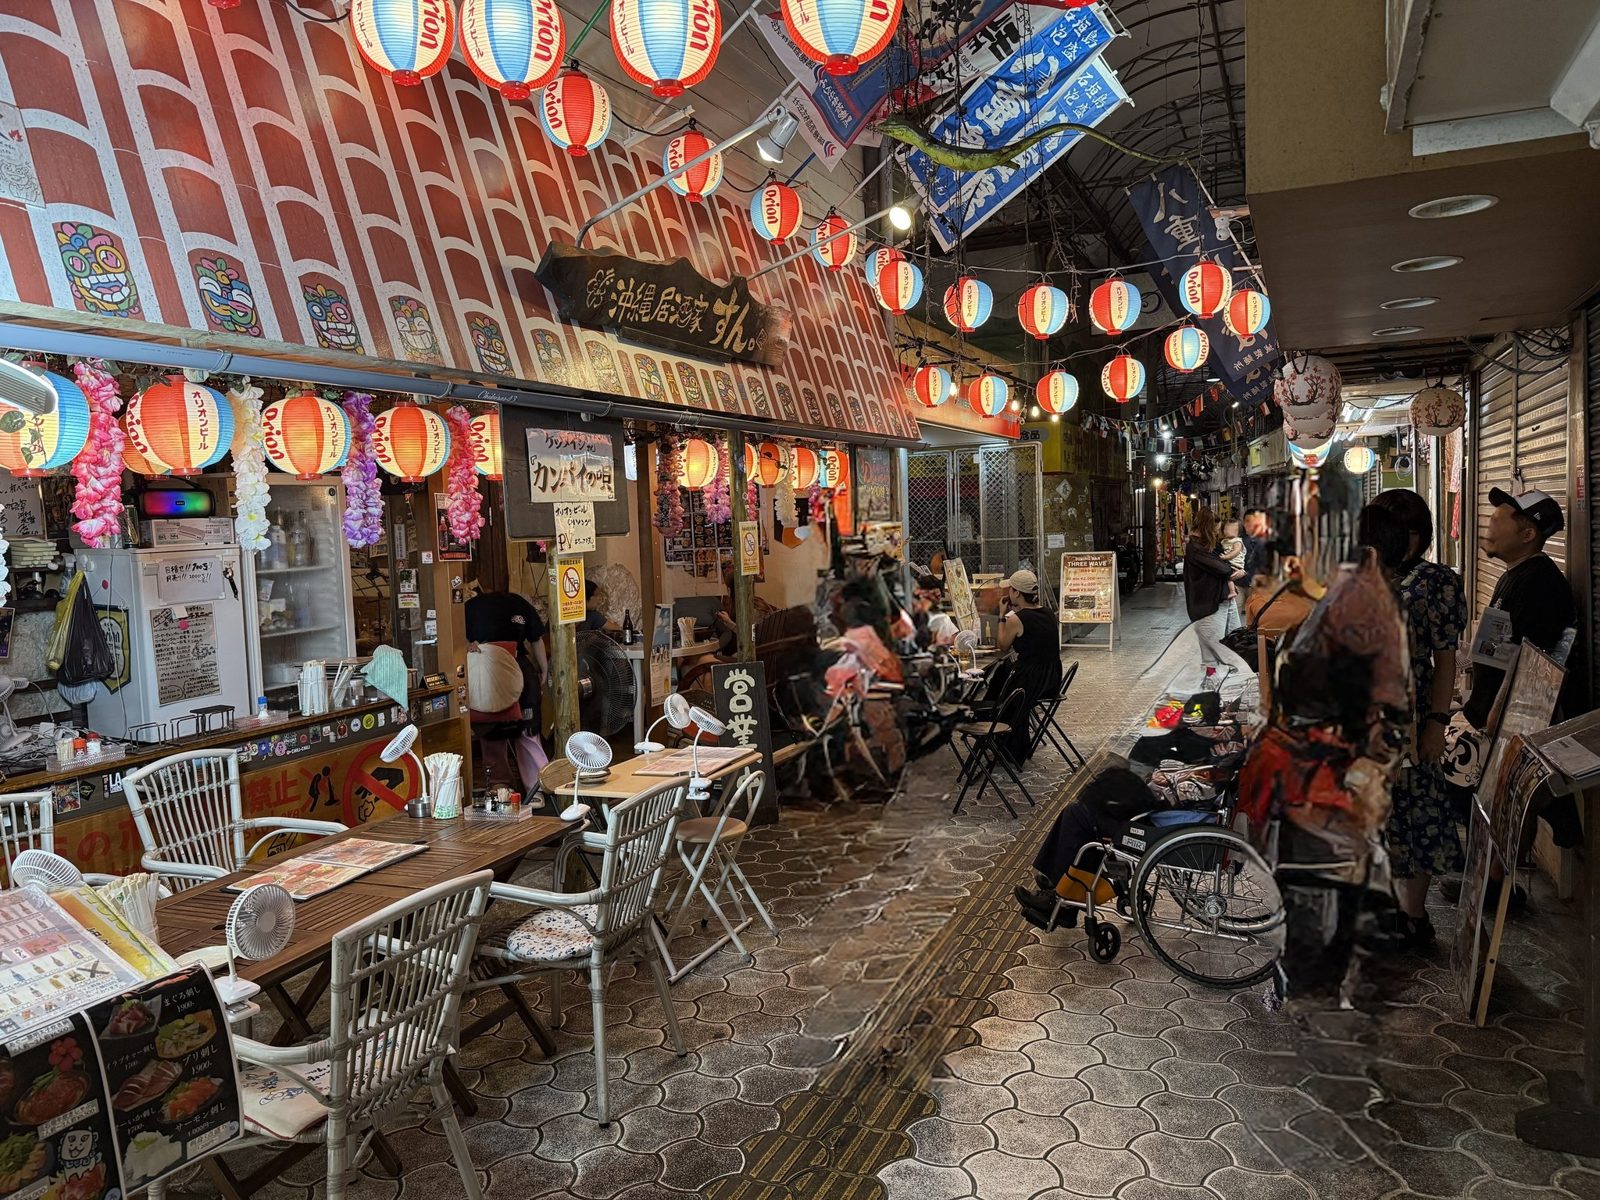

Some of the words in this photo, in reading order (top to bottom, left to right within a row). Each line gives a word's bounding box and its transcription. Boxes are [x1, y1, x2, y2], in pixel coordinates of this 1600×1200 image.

[419, 0, 445, 50] rion
[1050, 26, 1077, 61] 泡盛
[1063, 7, 1099, 48] 石垣島
[544, 81, 563, 130] Orion
[1063, 89, 1090, 121] 泡盛
[1076, 71, 1106, 109] 石垣島
[765, 189, 780, 225] Orion
[1188, 270, 1201, 305] Orion
[1200, 331, 1209, 362] Orion
[126, 393, 148, 455] Orion
[191, 391, 209, 451] オリオンビール
[262, 406, 285, 461] Orion
[323, 406, 338, 459] オリオンビール
[428, 417, 441, 465] オリオンビール
[470, 421, 490, 463] Orion
[245, 770, 301, 814] 禁止
